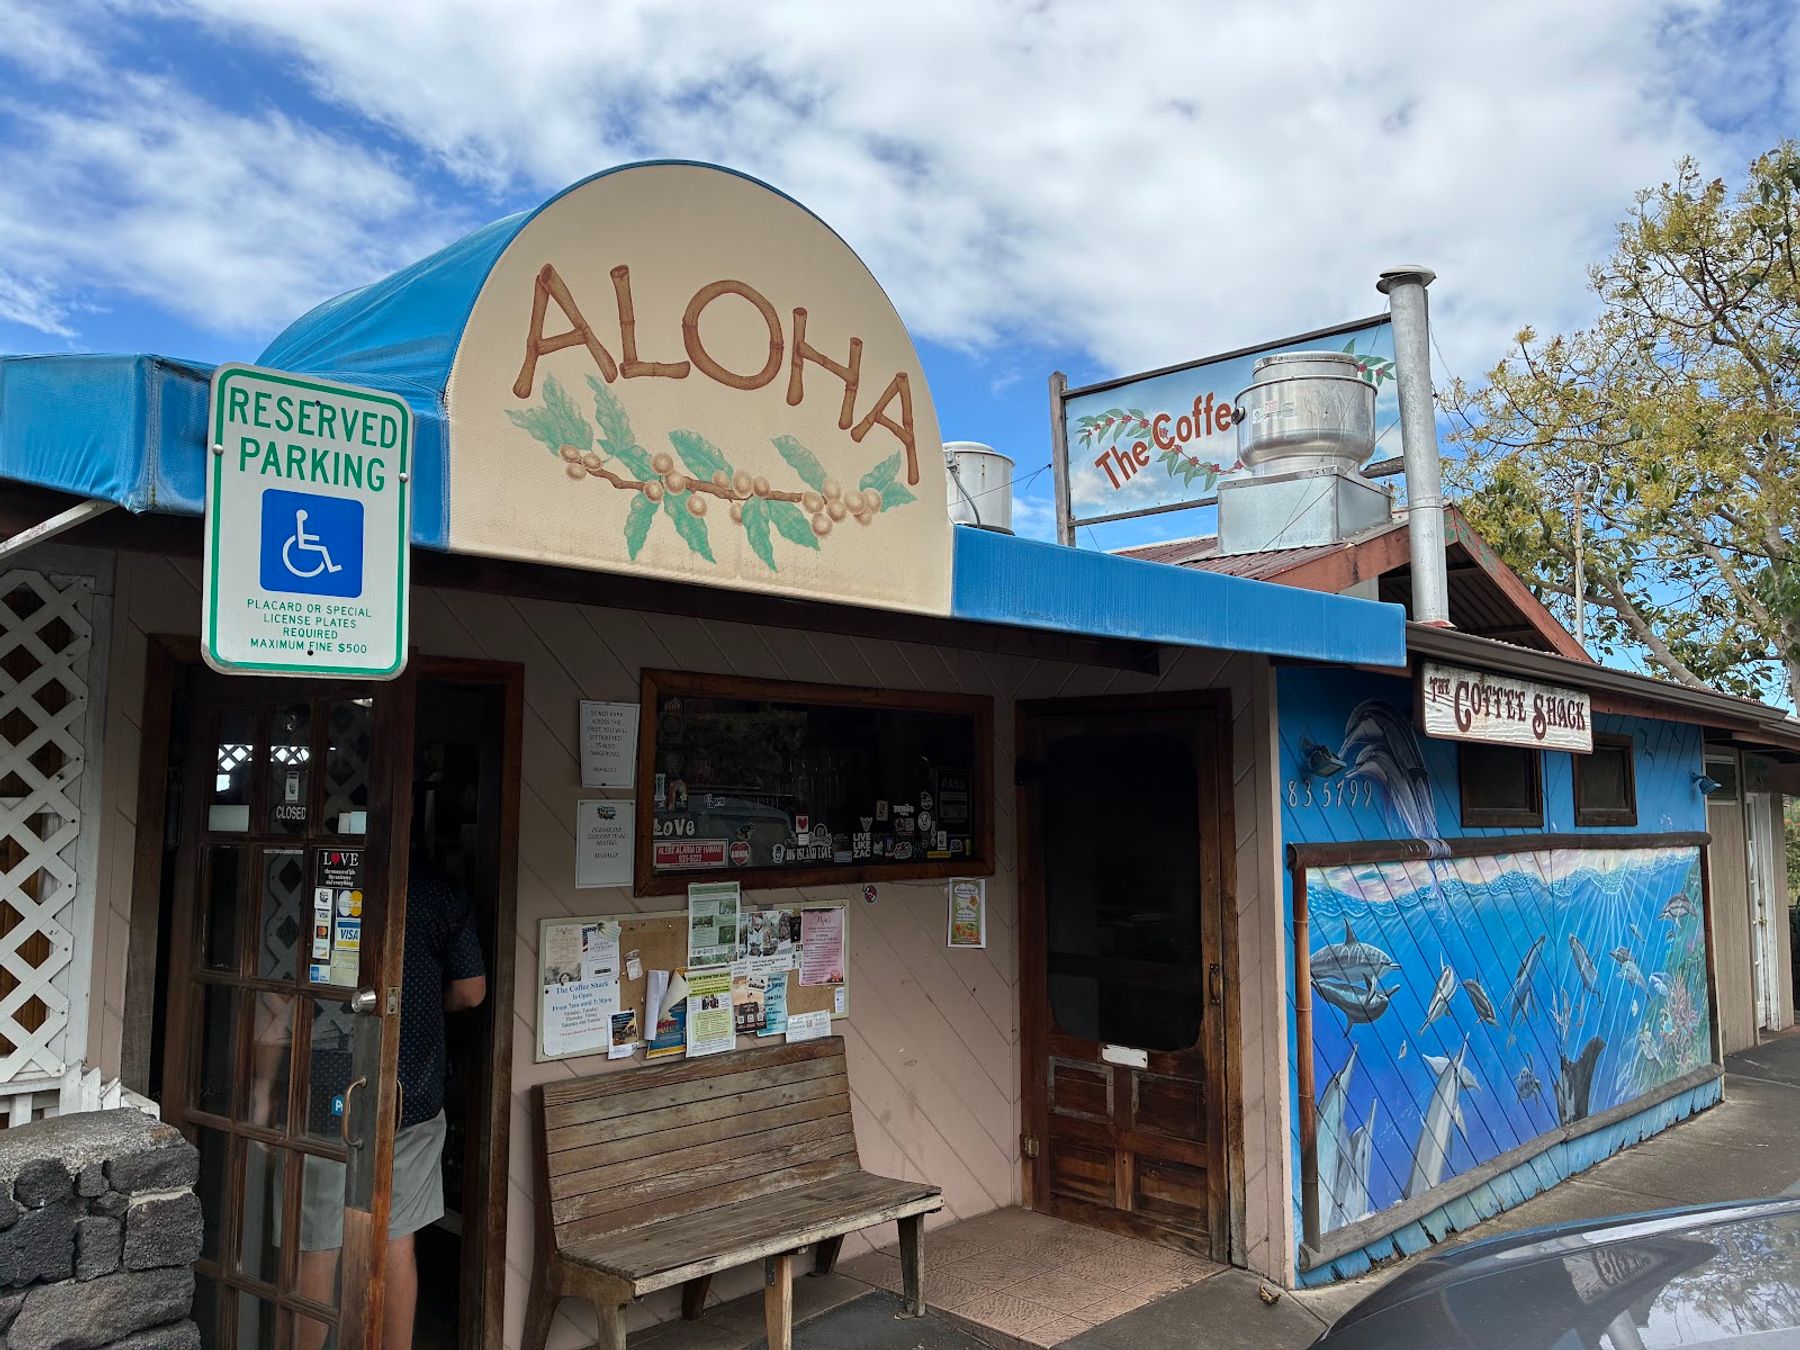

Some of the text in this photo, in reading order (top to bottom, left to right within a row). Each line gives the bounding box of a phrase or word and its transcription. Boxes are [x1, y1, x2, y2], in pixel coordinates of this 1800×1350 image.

[512, 263, 919, 486] ALOHA
[229, 387, 397, 449] RESERVED
[1094, 391, 1232, 491] The Coffe
[239, 437, 385, 492] PARKING
[247, 598, 372, 618] PLACARD OR SPECIAL
[263, 613, 357, 629] LICENSE PLATES
[283, 627, 338, 639] REQUIRED
[250, 638, 367, 654] MAXIMUM FINE $500
[1429, 676, 1586, 740] THE COFFEE SHACK
[276, 805, 307, 820] CLOSED
[853, 832, 871, 841] LIVE
[853, 841, 871, 850] LIKE
[853, 850, 871, 858] ZAC
[340, 929, 358, 941] VISA
